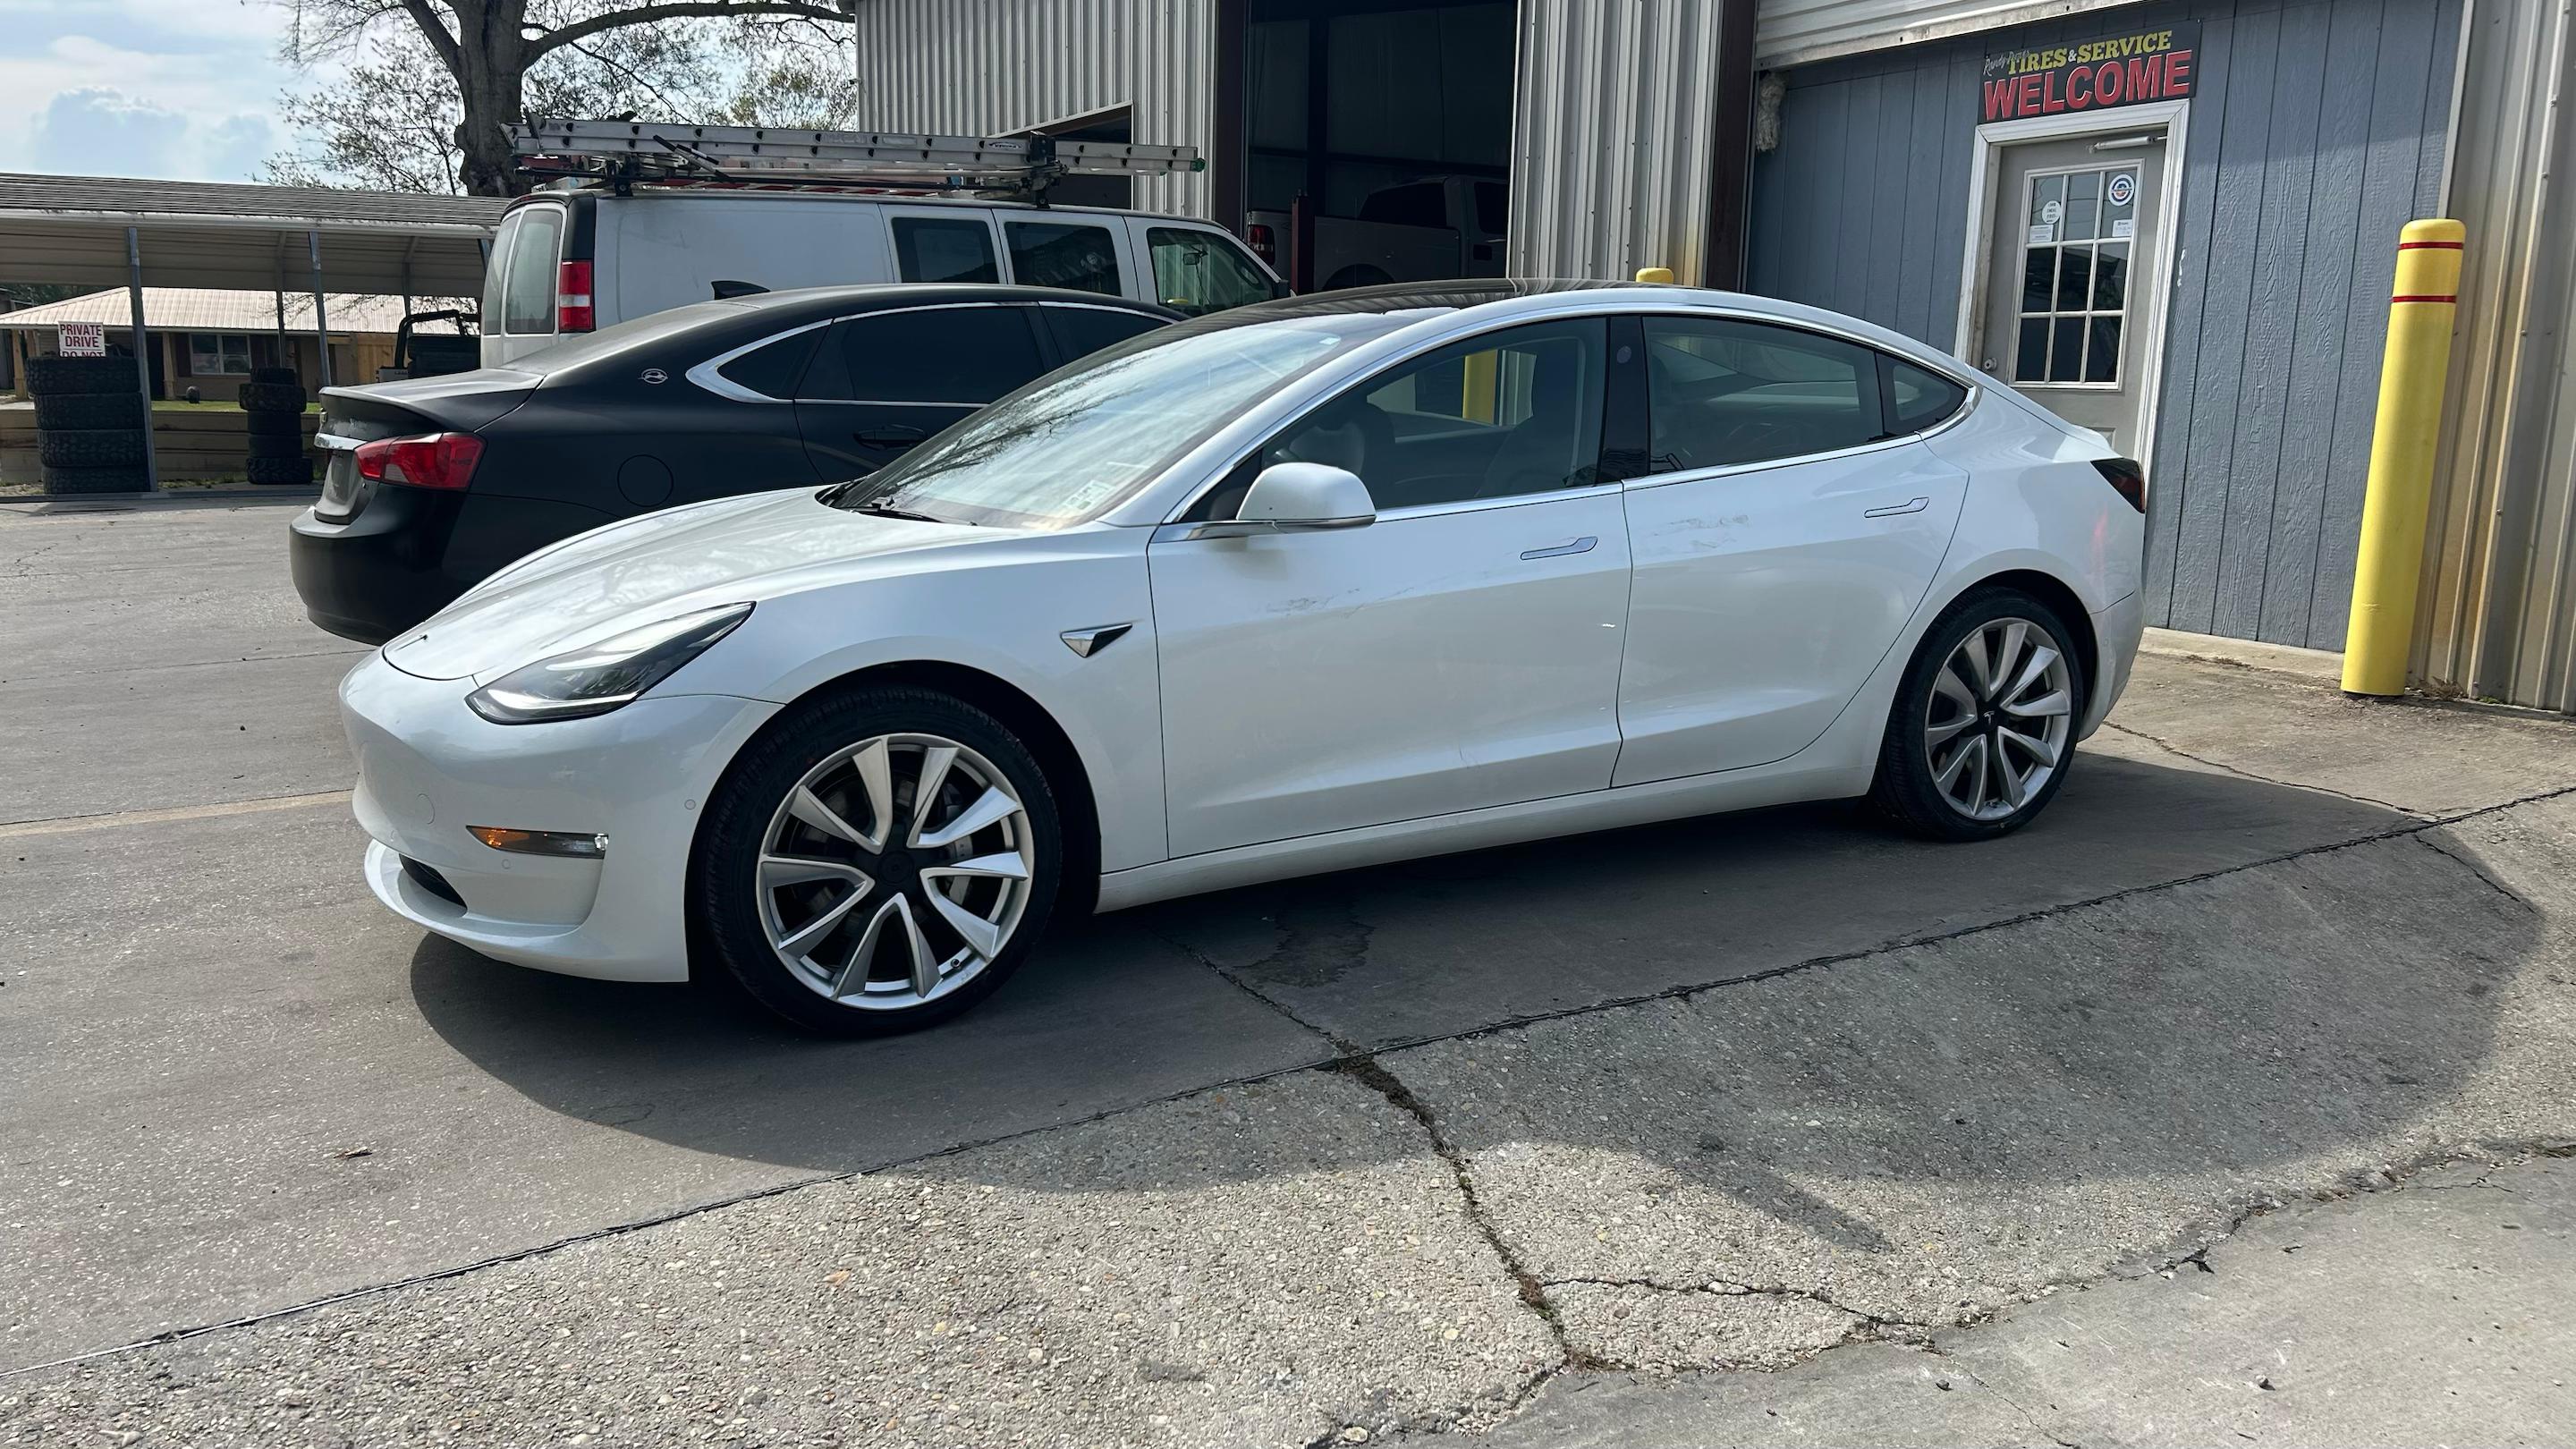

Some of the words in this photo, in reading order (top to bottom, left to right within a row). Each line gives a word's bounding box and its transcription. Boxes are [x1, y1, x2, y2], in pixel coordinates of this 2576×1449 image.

[2008, 47, 2067, 75] TIRES
[2077, 30, 2173, 64] SERVICE
[1984, 49, 2192, 121] WELCOME
[60, 324, 102, 335] PRIVATE
[65, 336, 99, 347] DRIVE
